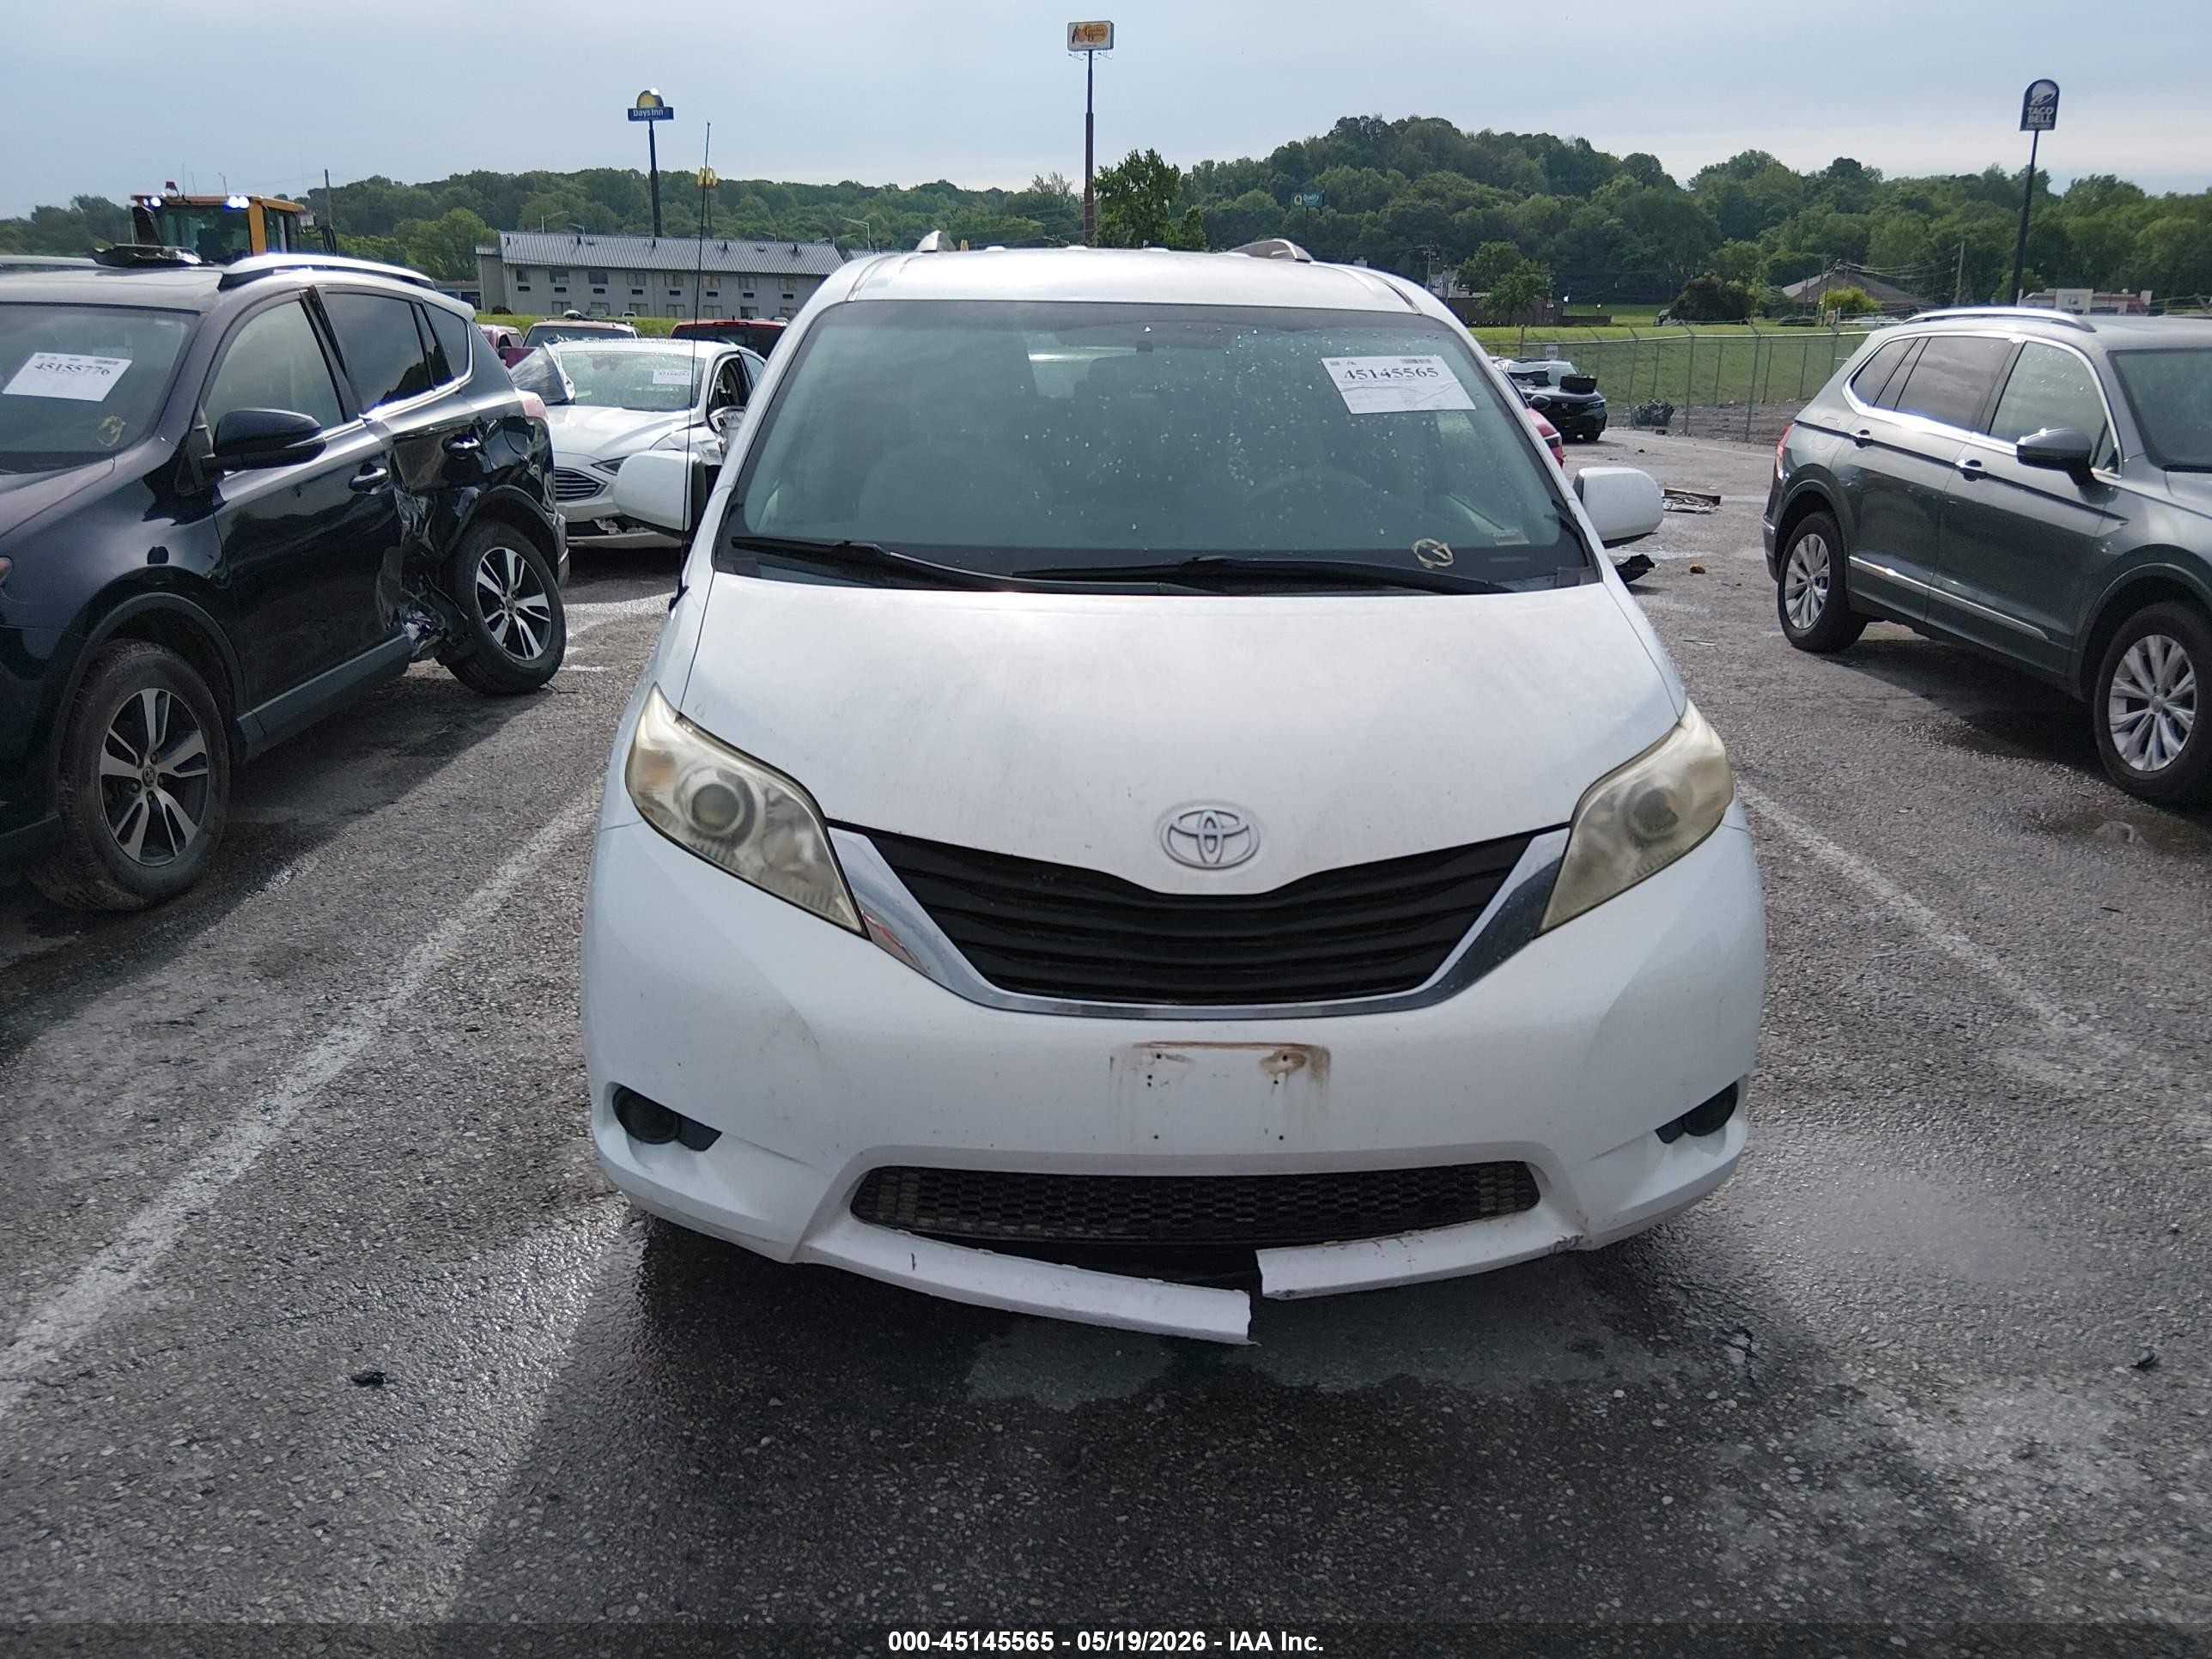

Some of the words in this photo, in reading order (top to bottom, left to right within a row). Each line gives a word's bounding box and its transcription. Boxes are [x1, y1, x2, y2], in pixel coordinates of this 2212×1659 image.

[2027, 106, 2054, 115] TACO
[2027, 114, 2052, 123] BELL
[1344, 368, 1438, 380] 45145565
